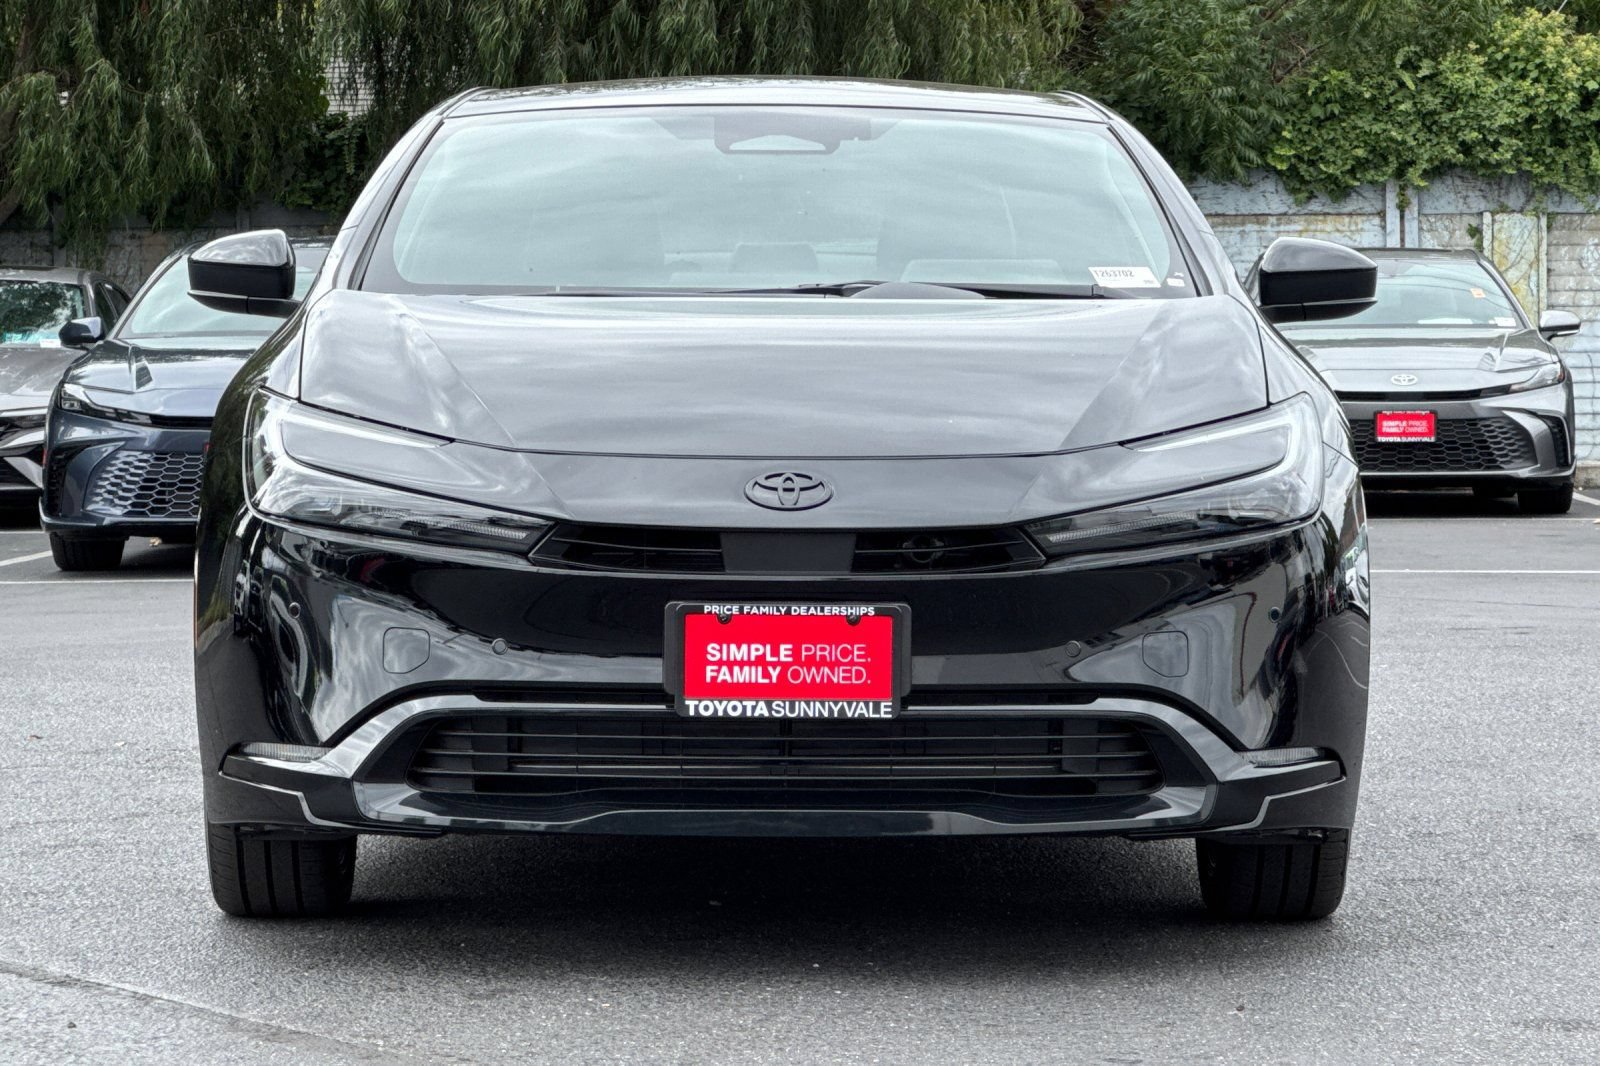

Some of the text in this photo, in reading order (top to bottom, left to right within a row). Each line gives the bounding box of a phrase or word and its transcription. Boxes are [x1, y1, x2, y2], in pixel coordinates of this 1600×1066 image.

[703, 605, 876, 617] PRICE FAMILY DEALERSHIPS
[706, 643, 872, 662] SIMPLE PRICE.
[705, 665, 872, 684] FAMILY OWNED.
[685, 700, 893, 718] TOYOTA SUNNYVALE
